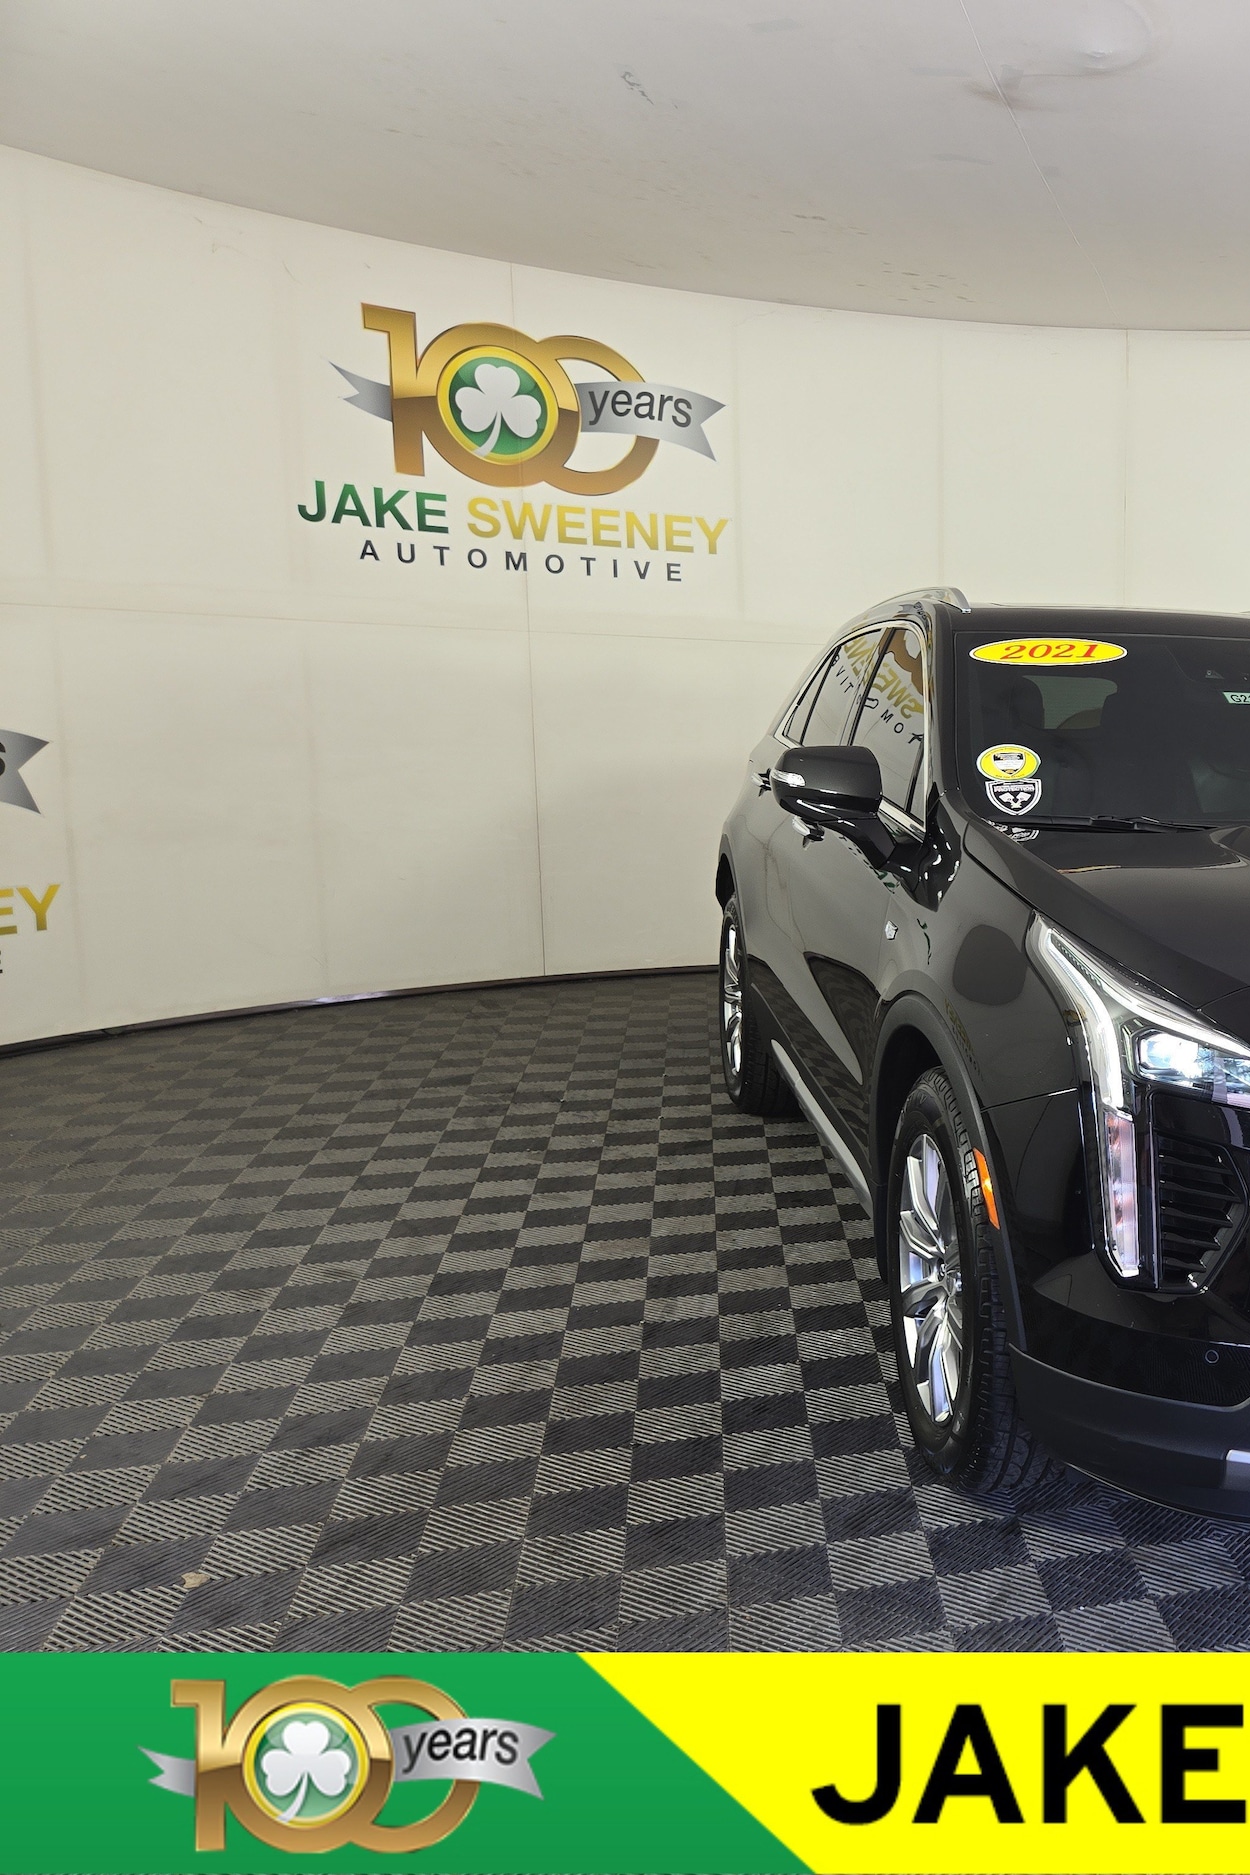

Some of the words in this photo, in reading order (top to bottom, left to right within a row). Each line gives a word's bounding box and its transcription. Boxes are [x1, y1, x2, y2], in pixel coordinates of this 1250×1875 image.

[587, 388, 693, 428] years
[297, 479, 449, 534] JAKE
[466, 496, 730, 555] SWEENEY
[359, 539, 682, 582] AUTOMOTIVE
[1000, 644, 1098, 660] 2021
